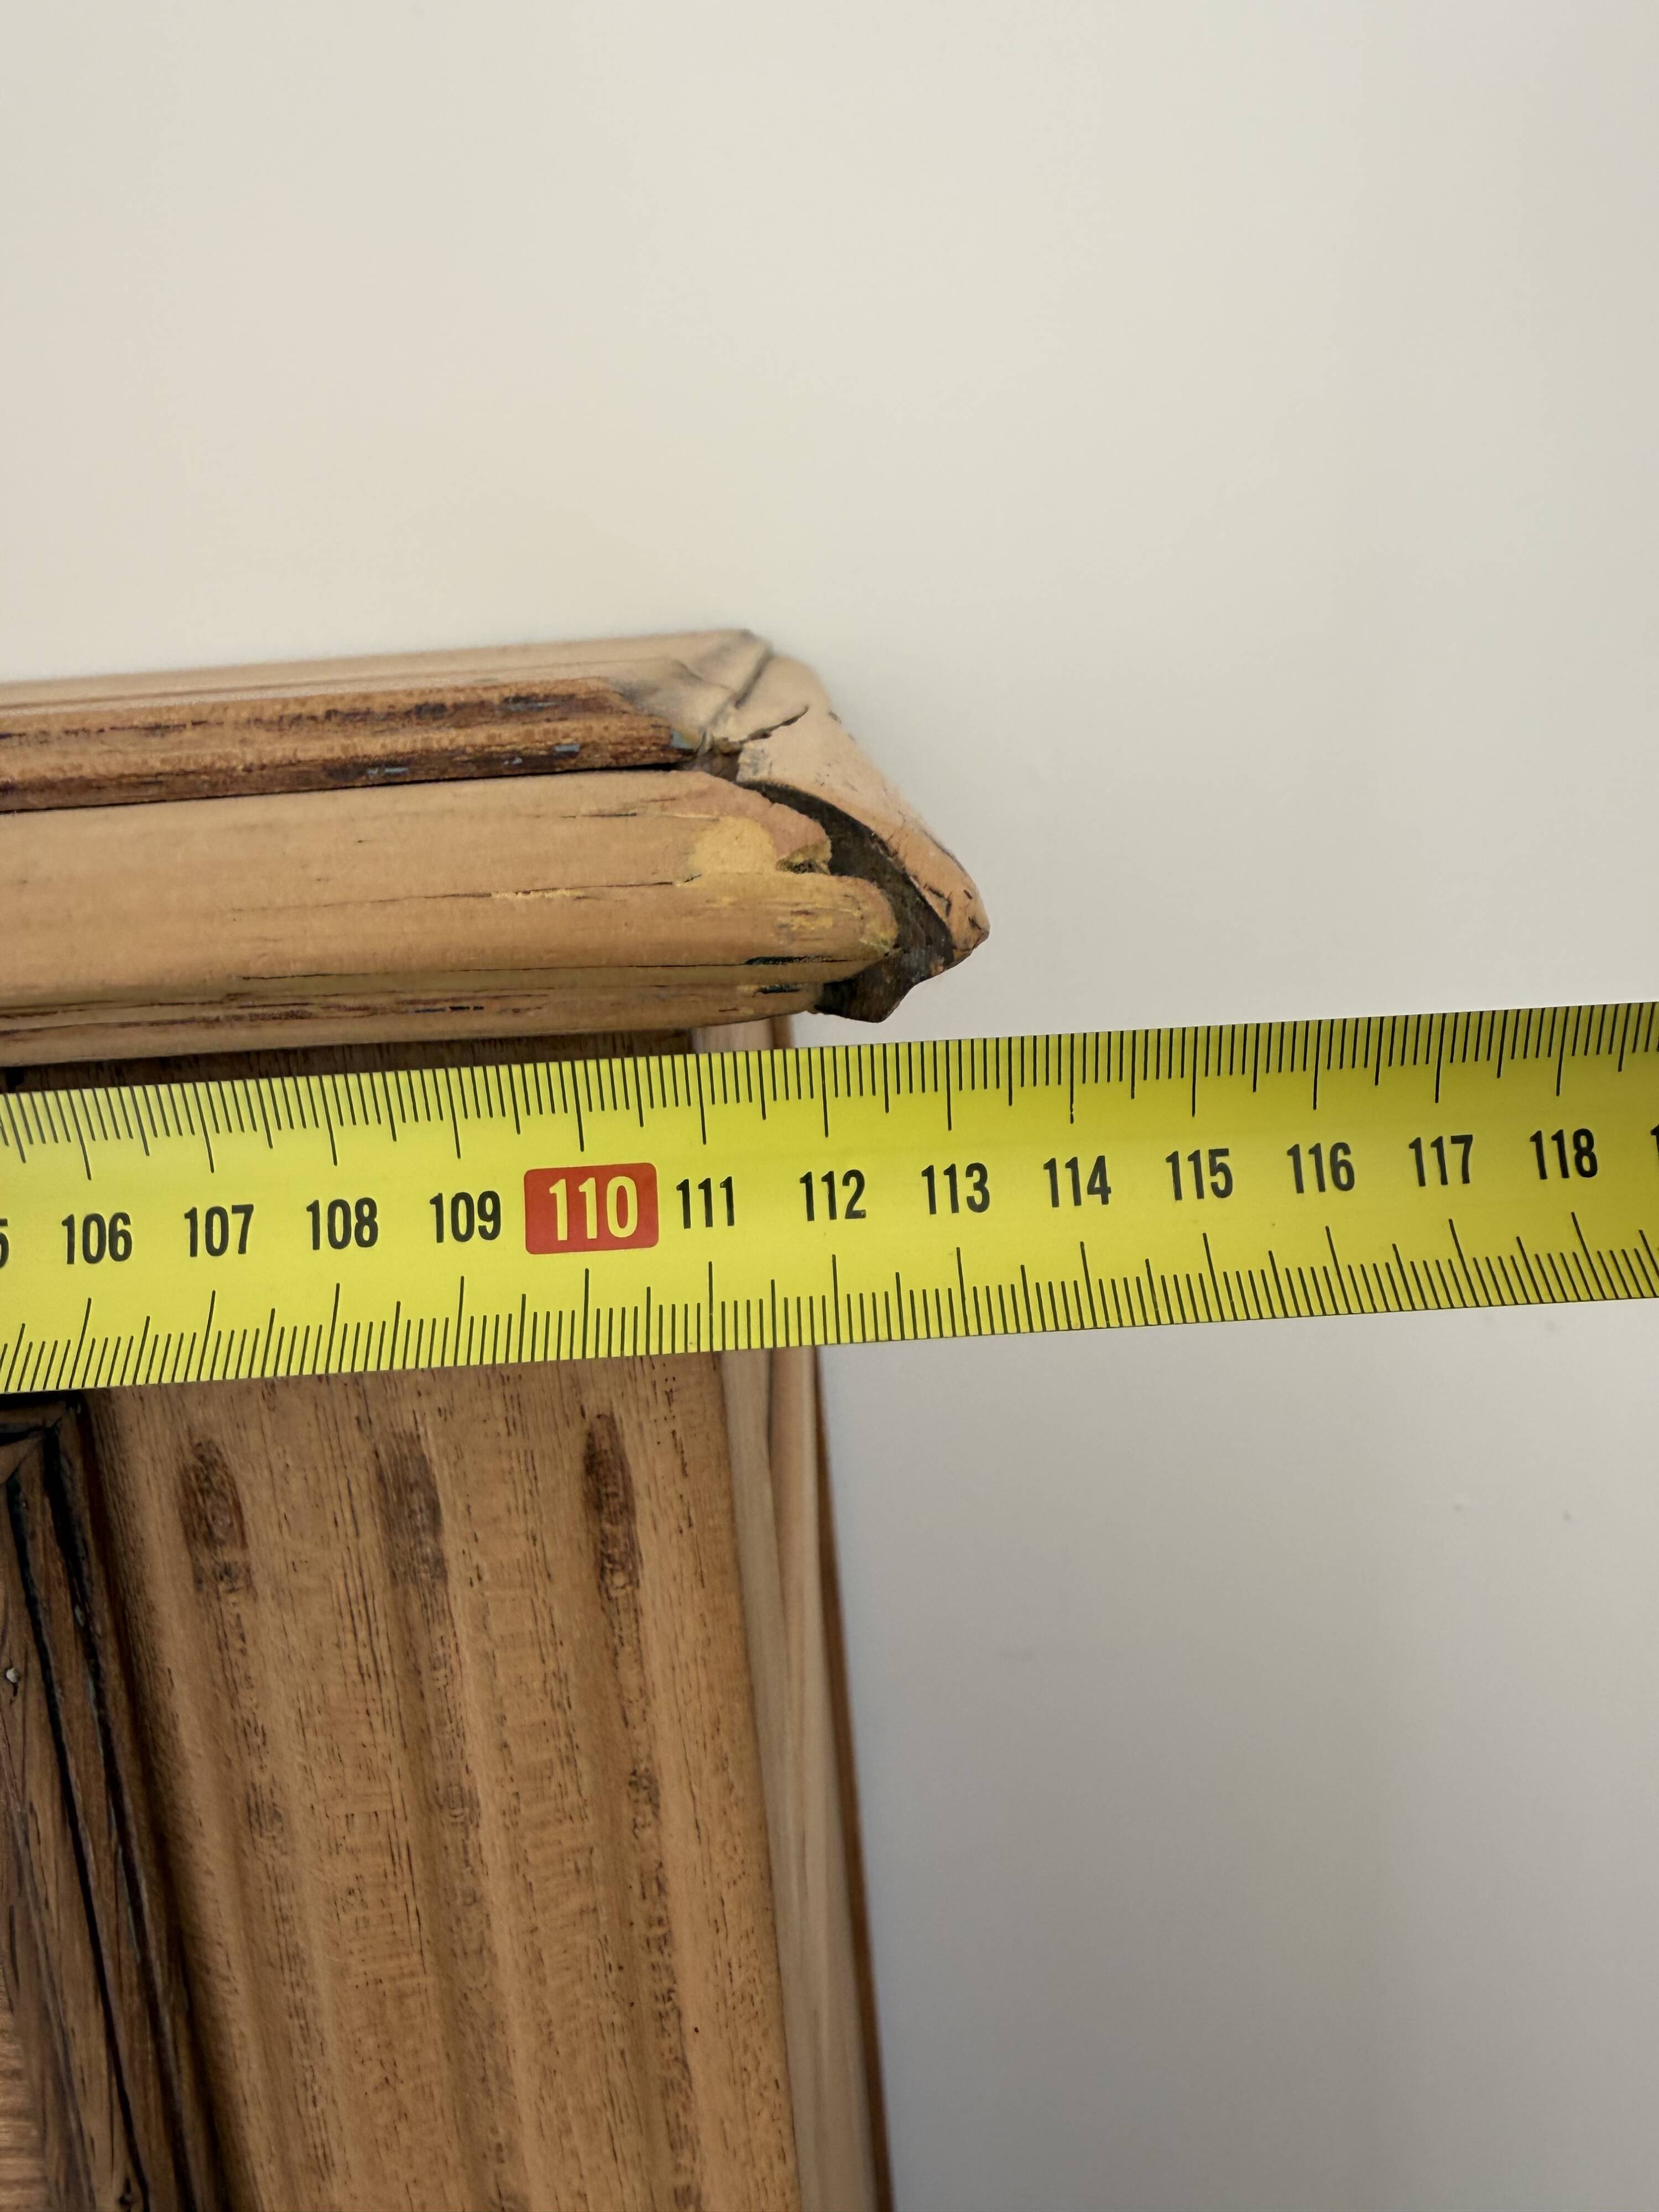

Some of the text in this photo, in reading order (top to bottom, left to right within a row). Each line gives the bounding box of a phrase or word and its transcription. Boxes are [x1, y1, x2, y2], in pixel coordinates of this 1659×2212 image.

[60, 1212, 133, 1265] 106
[183, 1204, 254, 1258] 107
[305, 1197, 379, 1251] 108
[429, 1190, 502, 1244] 109
[549, 1176, 639, 1241] 110
[675, 1176, 735, 1230] 111
[799, 1168, 867, 1222] 112
[921, 1162, 990, 1215] 113
[1042, 1155, 1112, 1208] 114
[1165, 1147, 1234, 1201] 115
[1286, 1141, 1355, 1194] 116
[1408, 1134, 1474, 1188] 117
[1529, 1127, 1599, 1181] 118
